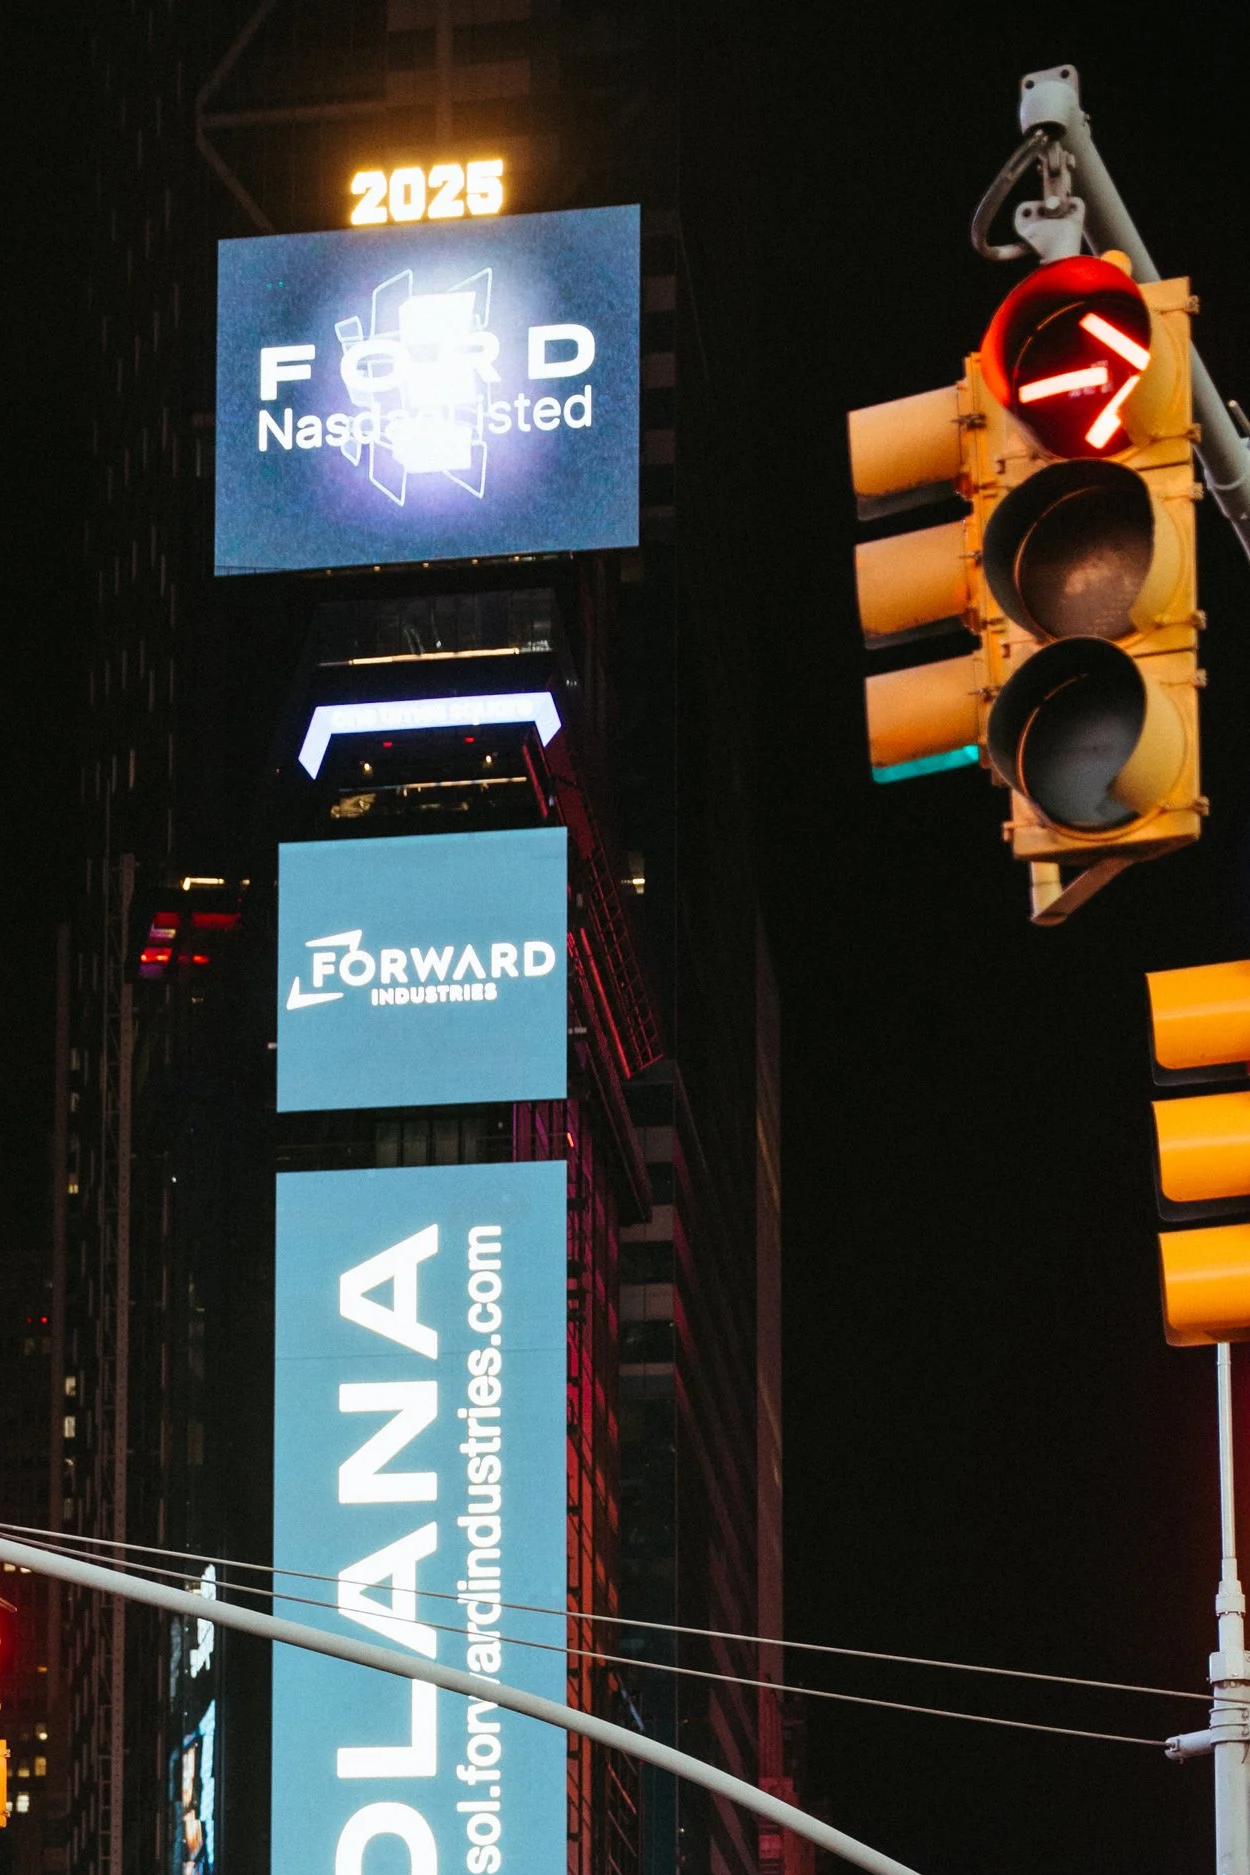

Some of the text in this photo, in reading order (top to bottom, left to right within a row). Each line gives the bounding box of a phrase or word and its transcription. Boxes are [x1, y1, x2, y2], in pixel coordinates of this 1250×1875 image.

[351, 160, 504, 225] 2025
[312, 938, 556, 988] FORWARD
[371, 982, 498, 1006] INDUSTRIES
